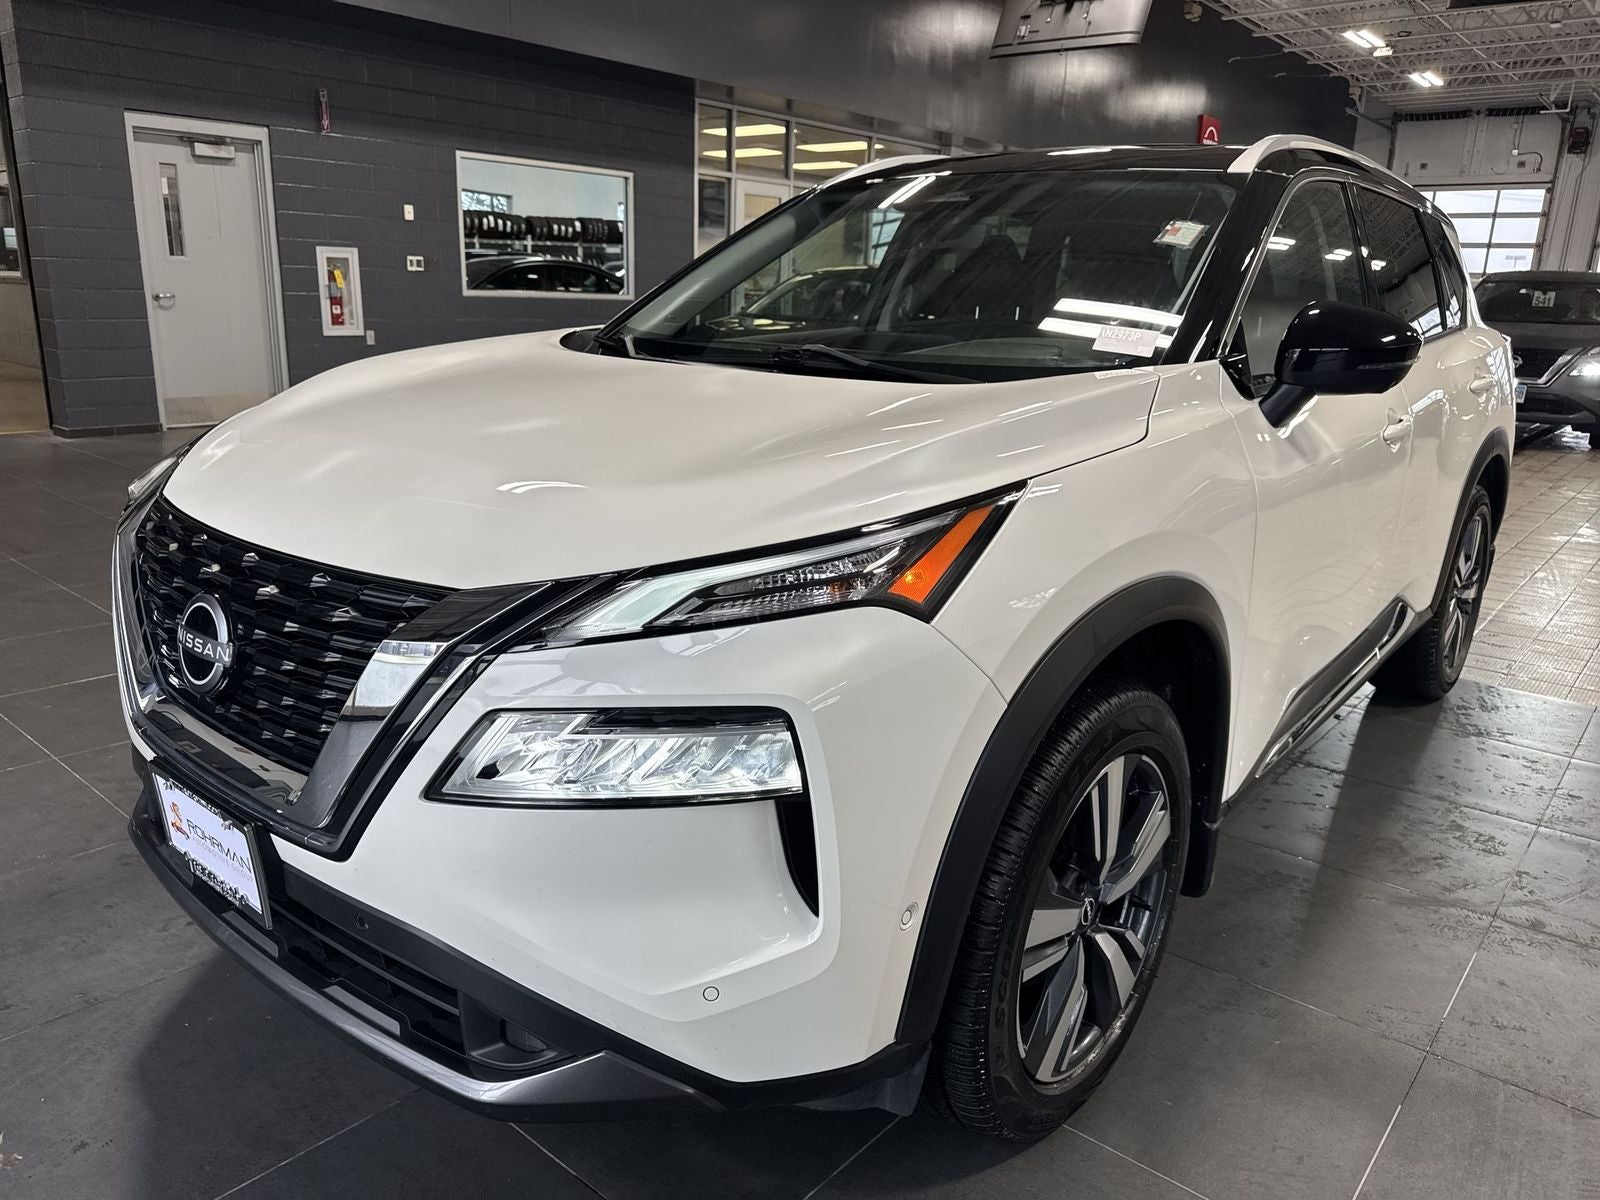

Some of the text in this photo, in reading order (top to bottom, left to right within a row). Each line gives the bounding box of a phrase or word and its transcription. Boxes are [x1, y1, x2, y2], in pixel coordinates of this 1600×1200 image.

[1534, 295, 1552, 306] 541
[178, 625, 230, 662] NISSAN
[186, 818, 252, 873] ROHRMAN
